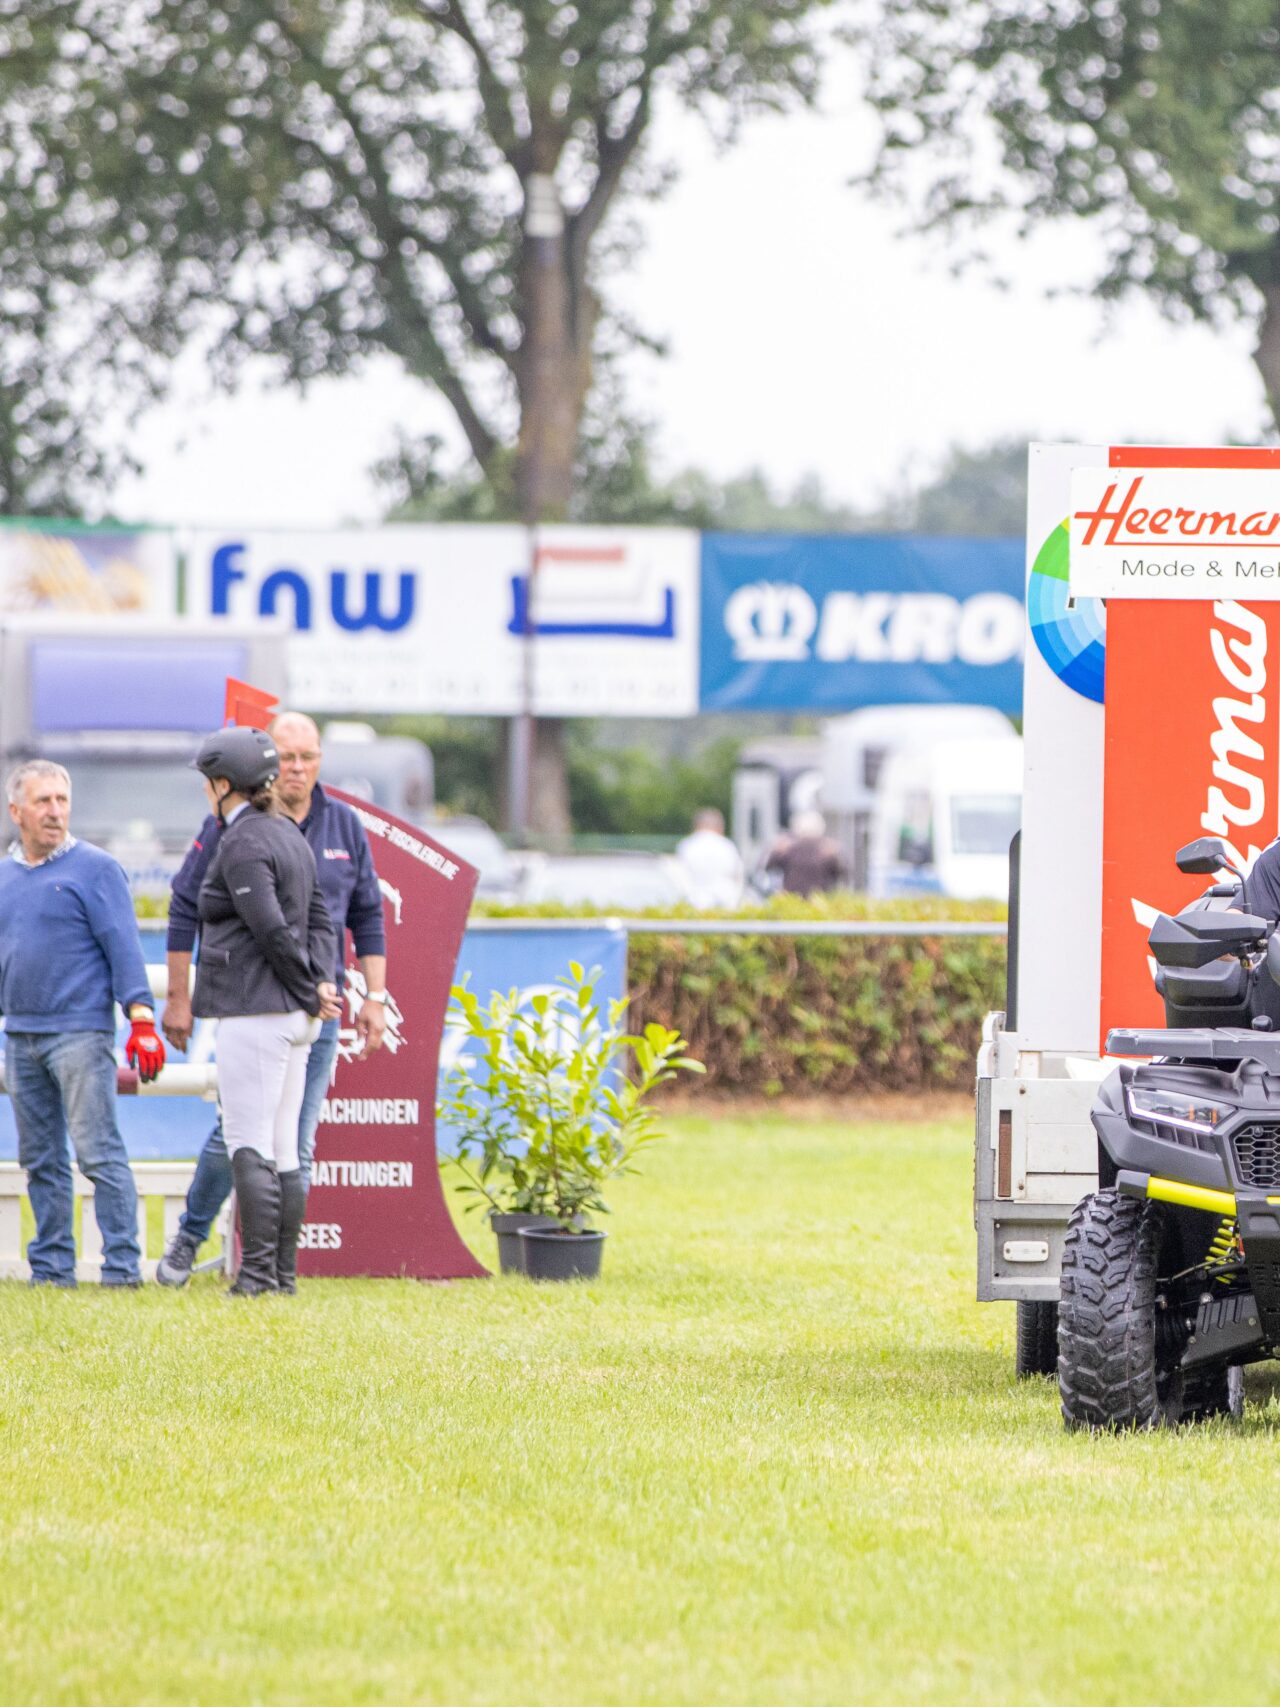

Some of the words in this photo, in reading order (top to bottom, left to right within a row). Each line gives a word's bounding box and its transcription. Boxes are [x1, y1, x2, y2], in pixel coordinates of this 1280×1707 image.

[1121, 559, 1195, 577] Mode
[1206, 560, 1223, 578] &
[816, 591, 1025, 666] KRO
